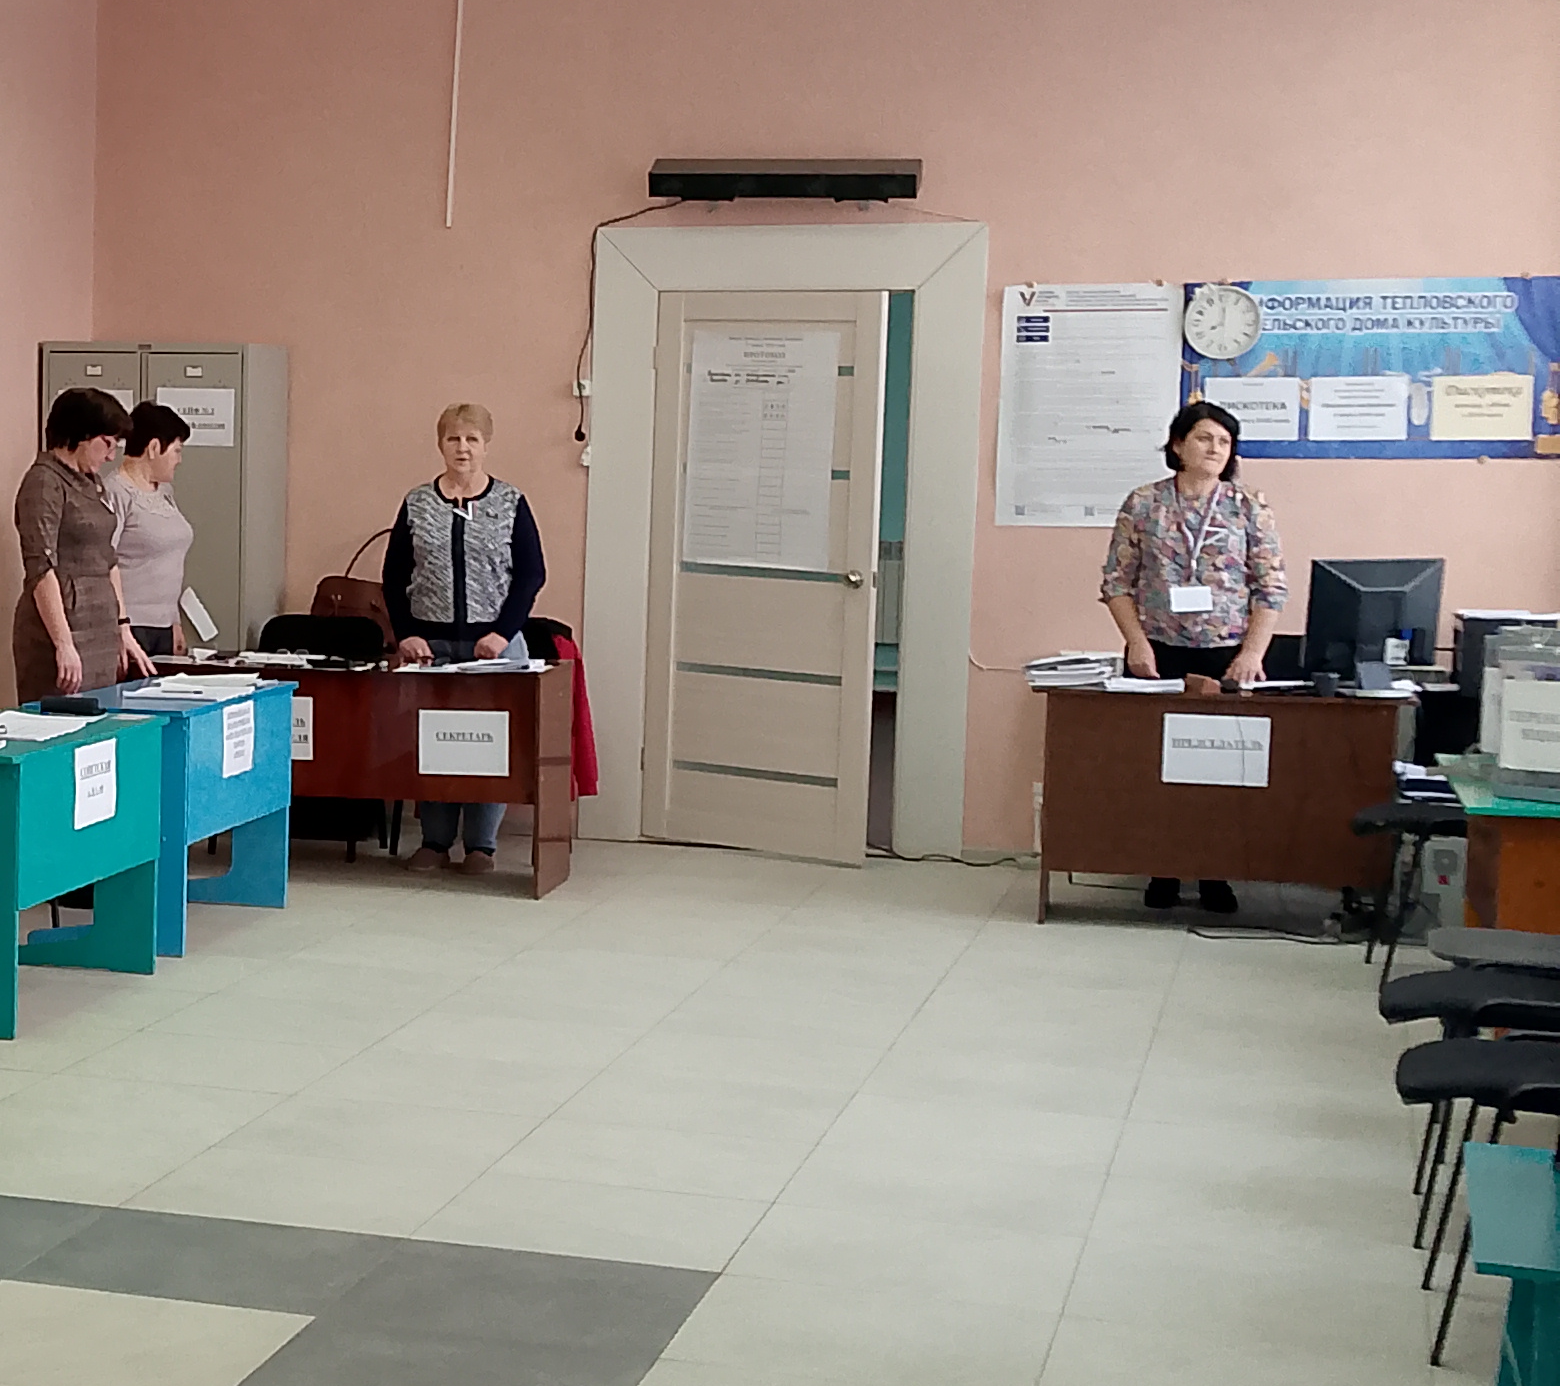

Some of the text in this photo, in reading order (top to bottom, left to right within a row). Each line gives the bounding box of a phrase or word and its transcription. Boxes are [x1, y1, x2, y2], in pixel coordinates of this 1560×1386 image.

[1258, 294, 1515, 312] ФОРМАЦИЯ ТЕПЛОВСКОГО
[1261, 316, 1500, 332] ЕЛЬСКОГО ДОМА КУЛЬТУРЫ
[435, 731, 494, 743] СЕКРЕТАРЬ
